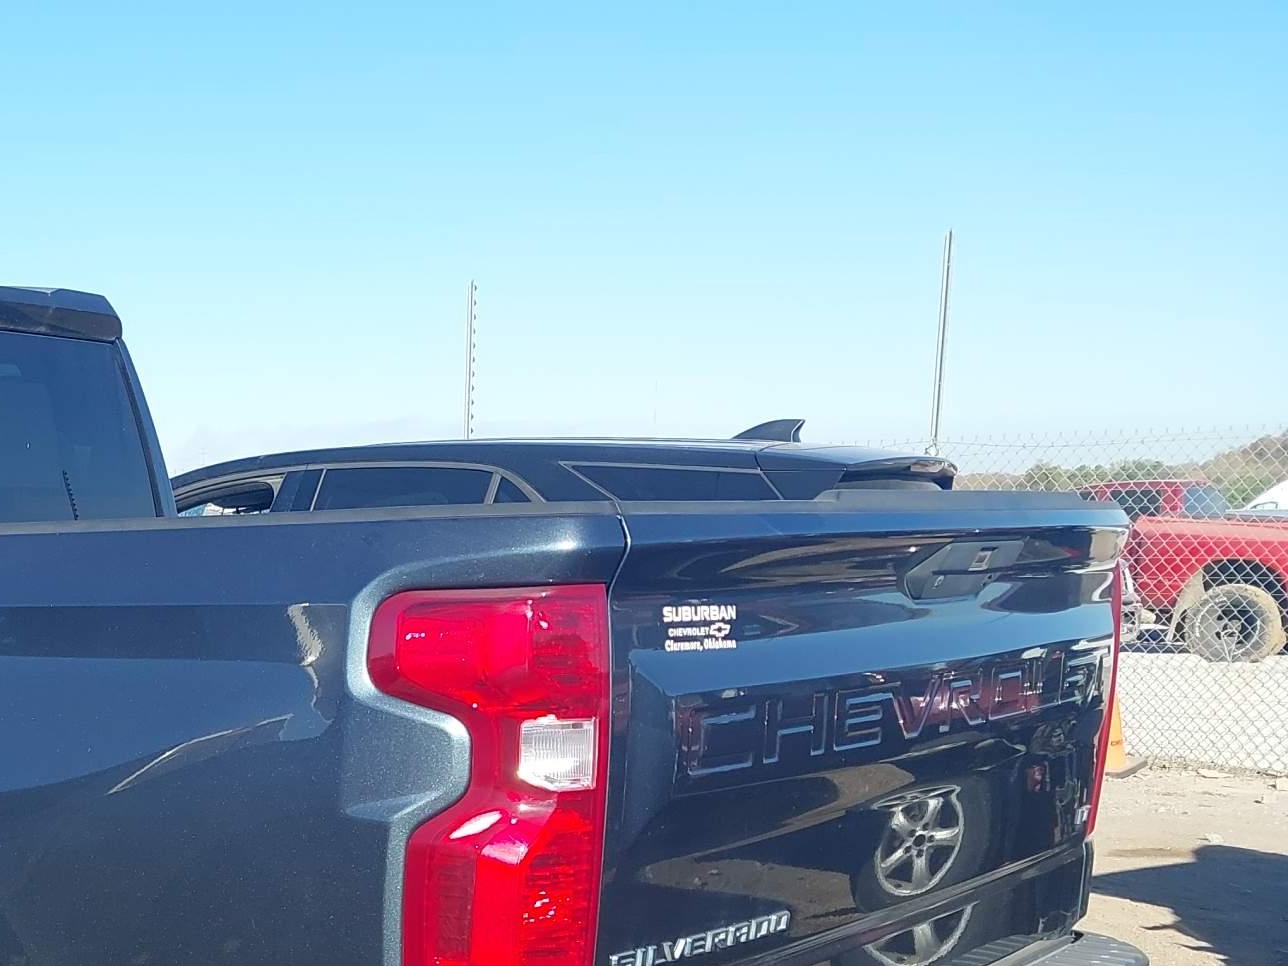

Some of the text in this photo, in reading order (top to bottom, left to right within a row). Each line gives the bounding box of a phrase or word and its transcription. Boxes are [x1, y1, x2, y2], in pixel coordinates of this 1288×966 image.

[663, 605, 736, 622] SUBURBAN
[668, 627, 709, 637] CHEVROLET
[704, 638, 736, 650] Oklahoma
[682, 650, 1109, 774] CHEVROLET
